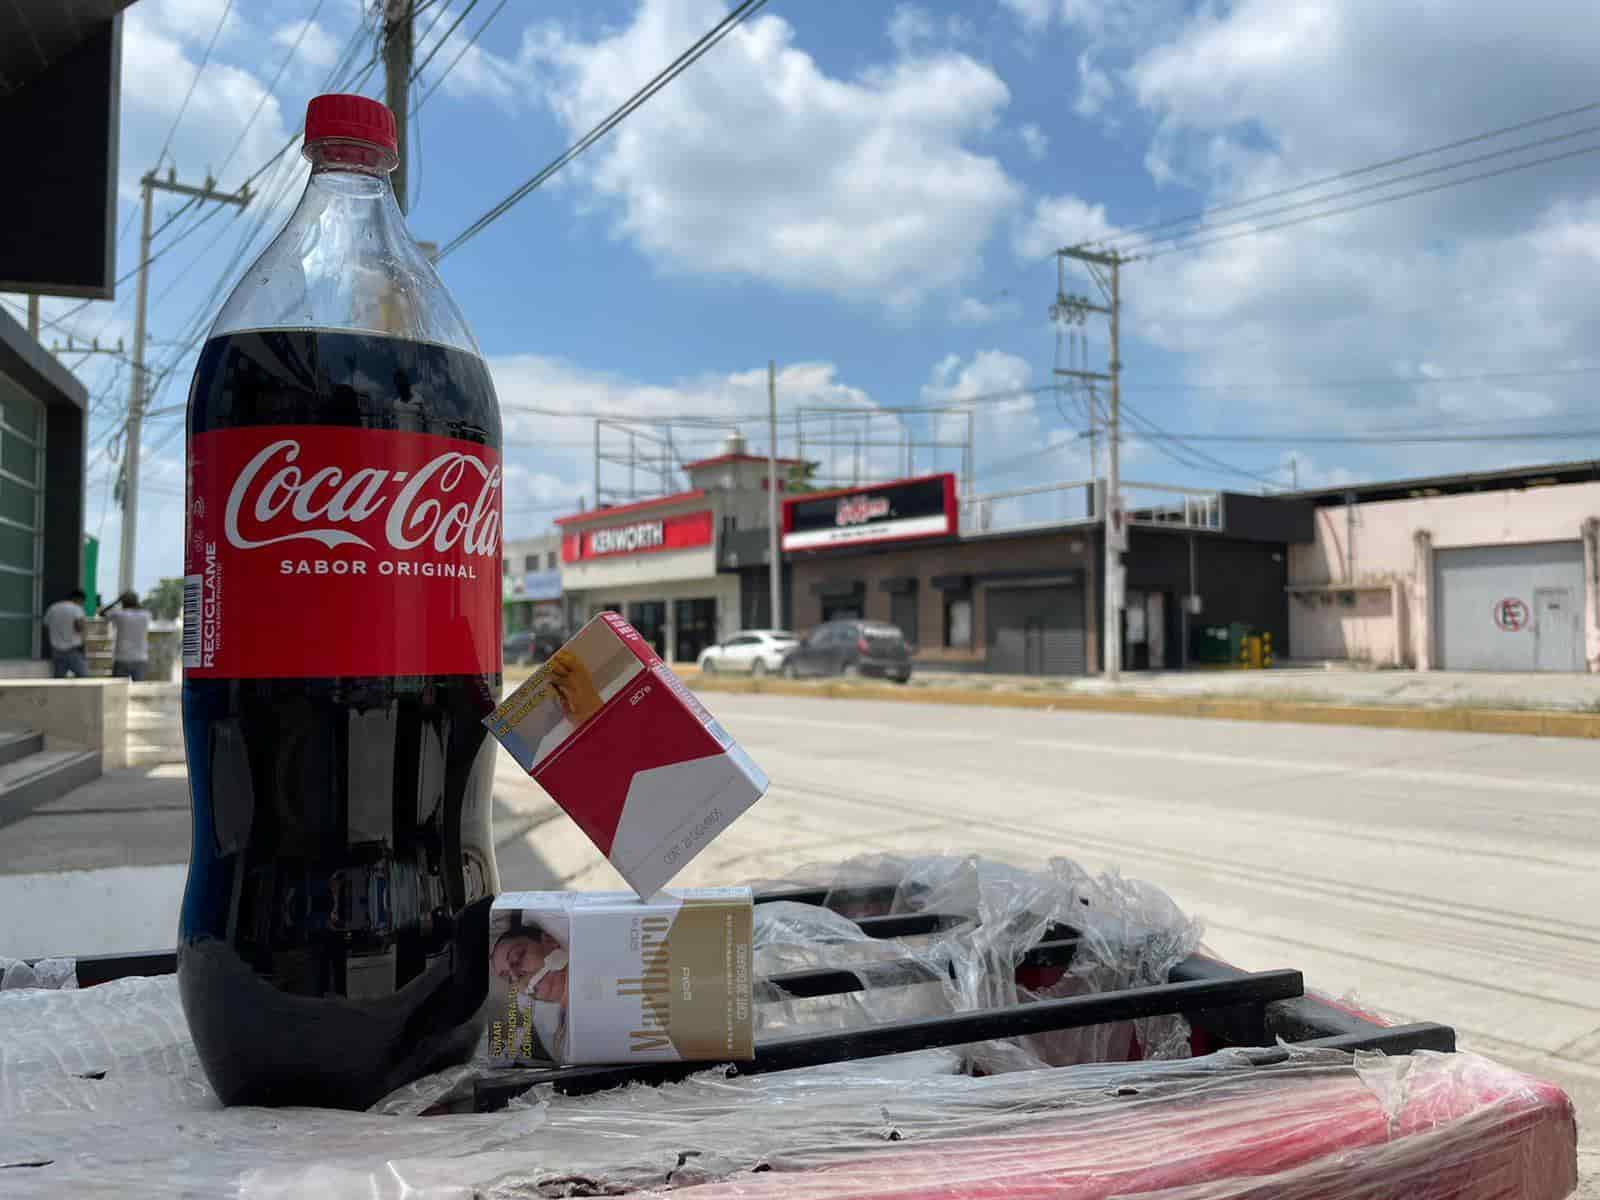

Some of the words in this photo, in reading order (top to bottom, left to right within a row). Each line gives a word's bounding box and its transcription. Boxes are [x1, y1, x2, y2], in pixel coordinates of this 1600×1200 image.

[224, 439, 501, 557] Coca-Cola
[592, 520, 664, 553] KENWORTH
[203, 541, 217, 668] RECICLAME
[280, 560, 367, 575] SABOR
[378, 560, 477, 579] ORIGINAL
[615, 915, 671, 1052] Marlboro
